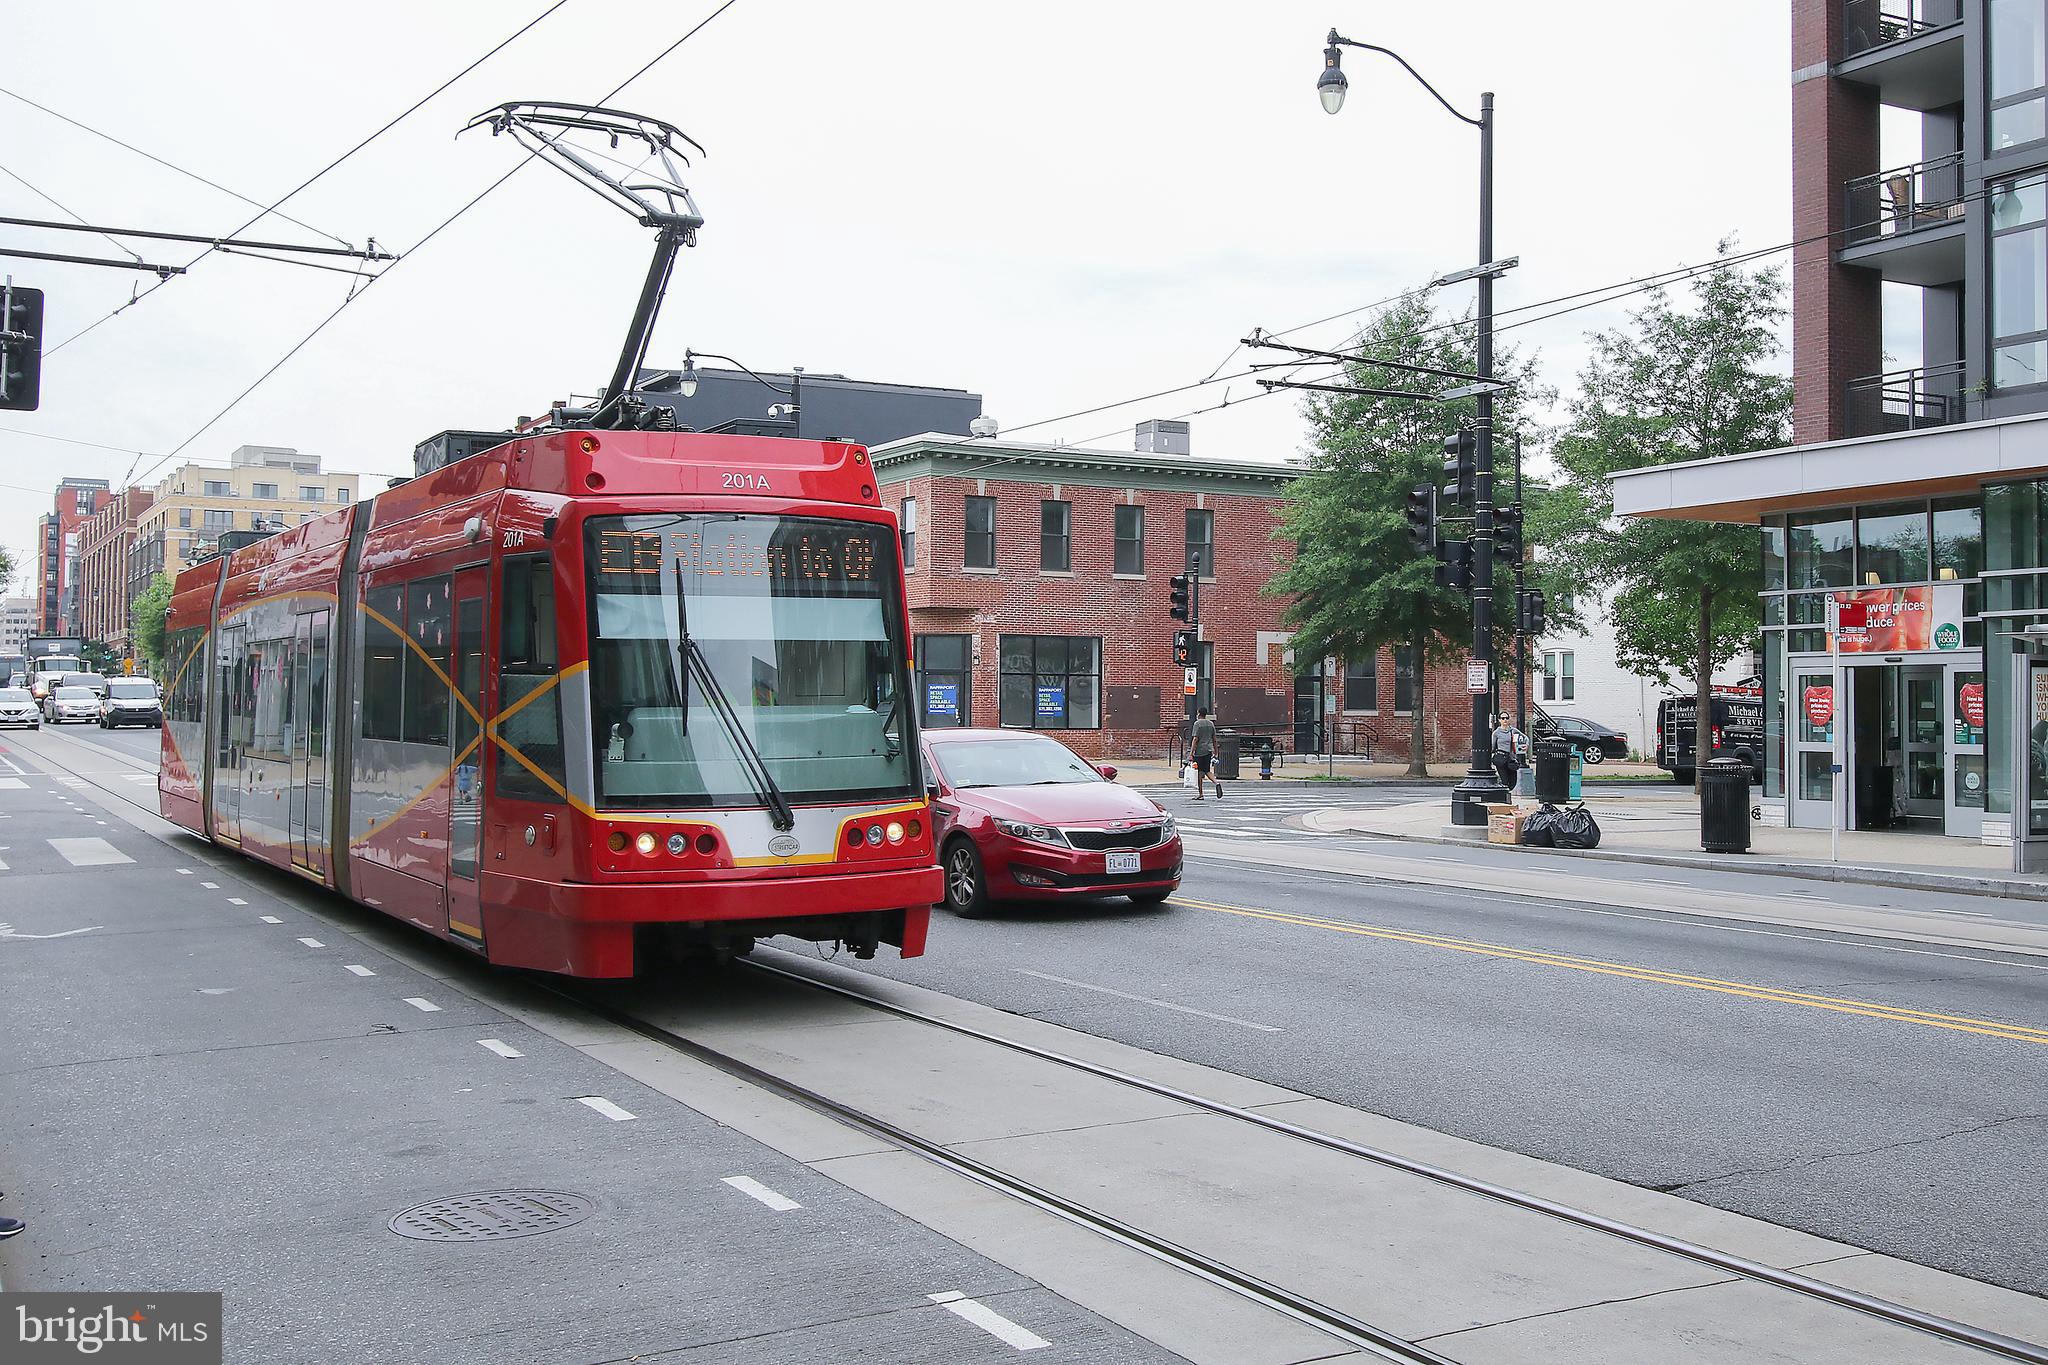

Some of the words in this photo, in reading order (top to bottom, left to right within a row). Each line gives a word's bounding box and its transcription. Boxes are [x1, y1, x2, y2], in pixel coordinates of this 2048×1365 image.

[721, 473, 771, 490] 201A
[502, 531, 524, 548] 201A
[800, 537, 833, 578] to
[1892, 600, 1925, 615] prices
[2036, 673, 2048, 682] SU
[1728, 705, 1758, 717] Michael
[2036, 702, 2048, 711] YO
[1109, 858, 1117, 868] FL
